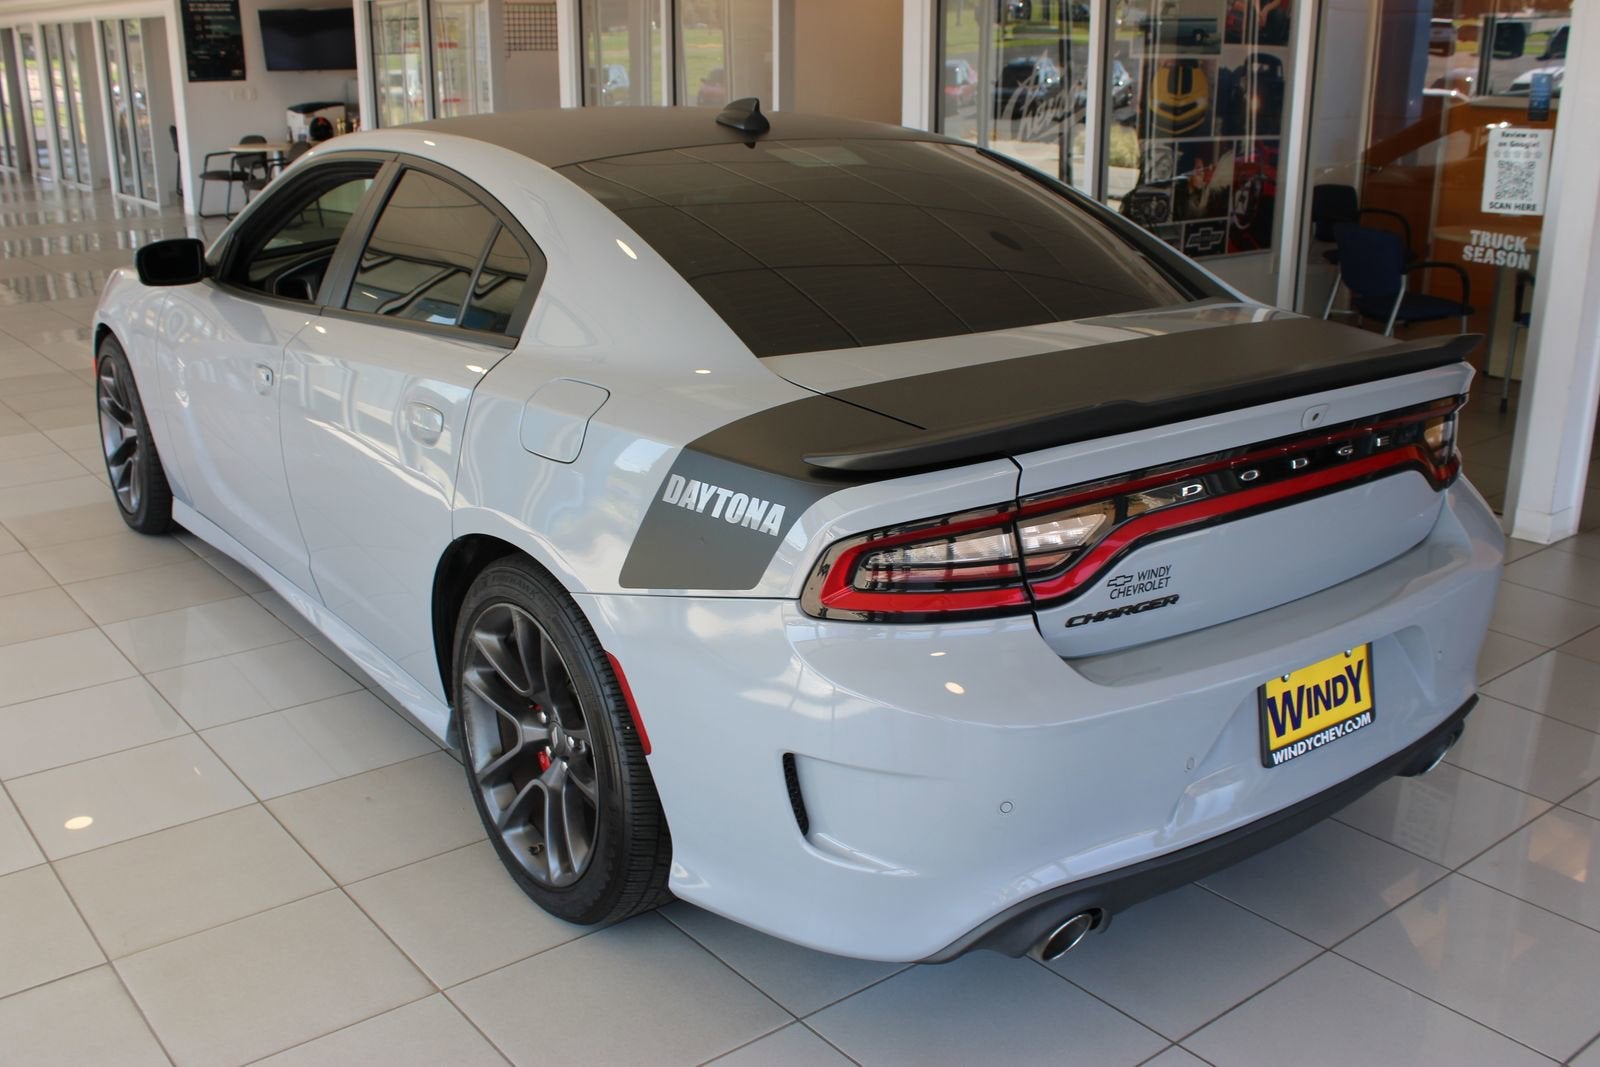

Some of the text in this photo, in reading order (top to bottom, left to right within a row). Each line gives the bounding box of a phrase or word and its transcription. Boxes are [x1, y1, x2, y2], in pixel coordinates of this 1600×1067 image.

[1501, 131, 1527, 139] Review
[1489, 201, 1537, 212] SCAN HERE
[1470, 229, 1528, 252] TRUCK
[1462, 244, 1532, 270] SEASON
[1181, 436, 1390, 497] DODGE
[662, 473, 786, 537] DAYTONA
[1137, 564, 1172, 582] WINDY
[1109, 576, 1171, 600] CHEVROLET
[1065, 594, 1180, 628] CHARGER
[1266, 658, 1365, 738] WINDY
[1272, 711, 1372, 765] WINDYCHEV.COM
